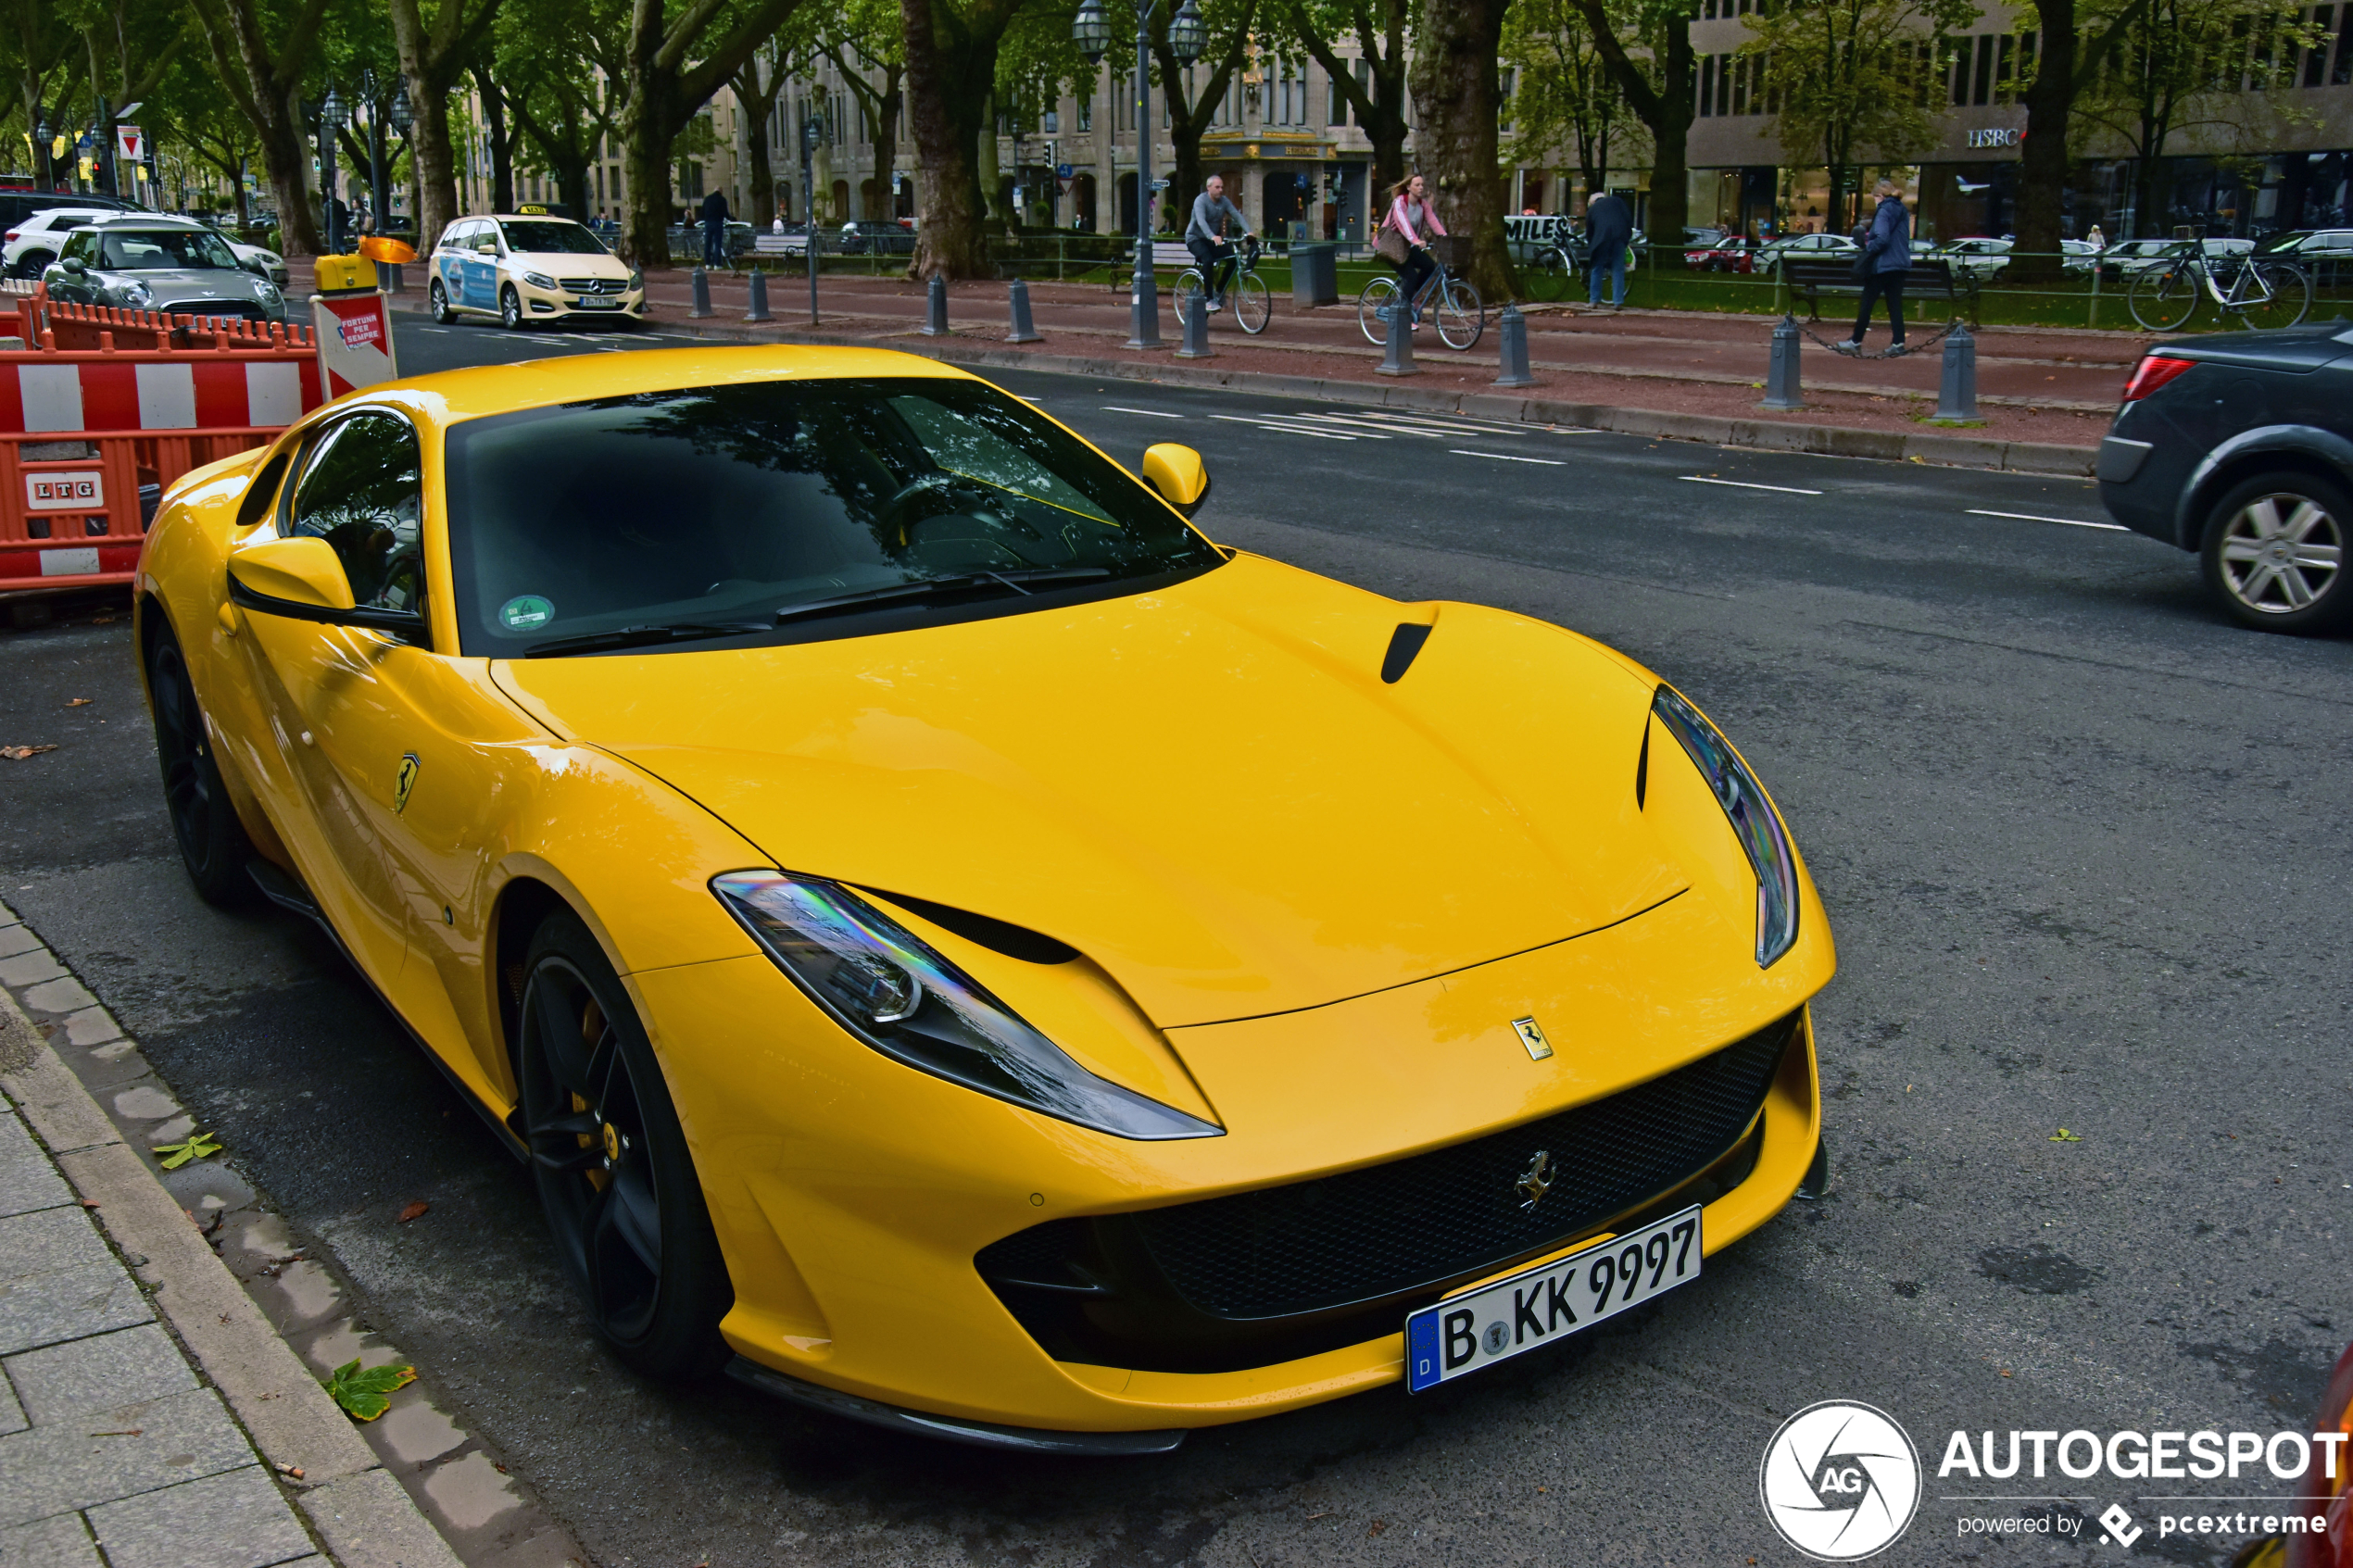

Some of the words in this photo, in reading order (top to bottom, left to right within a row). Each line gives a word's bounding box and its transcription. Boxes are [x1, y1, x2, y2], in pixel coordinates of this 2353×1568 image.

[1967, 129, 2018, 147] HSBC
[1504, 218, 1568, 241] MILES
[341, 314, 377, 328] FORTUNA
[353, 324, 369, 333] PER
[346, 330, 379, 343] SEMPRE
[38, 483, 93, 497] LTG
[520, 600, 533, 613] 4
[1419, 1358, 1430, 1376] D
[1444, 1308, 1477, 1370] B
[1515, 1268, 1578, 1345] KK
[1590, 1217, 1695, 1314] 9997
